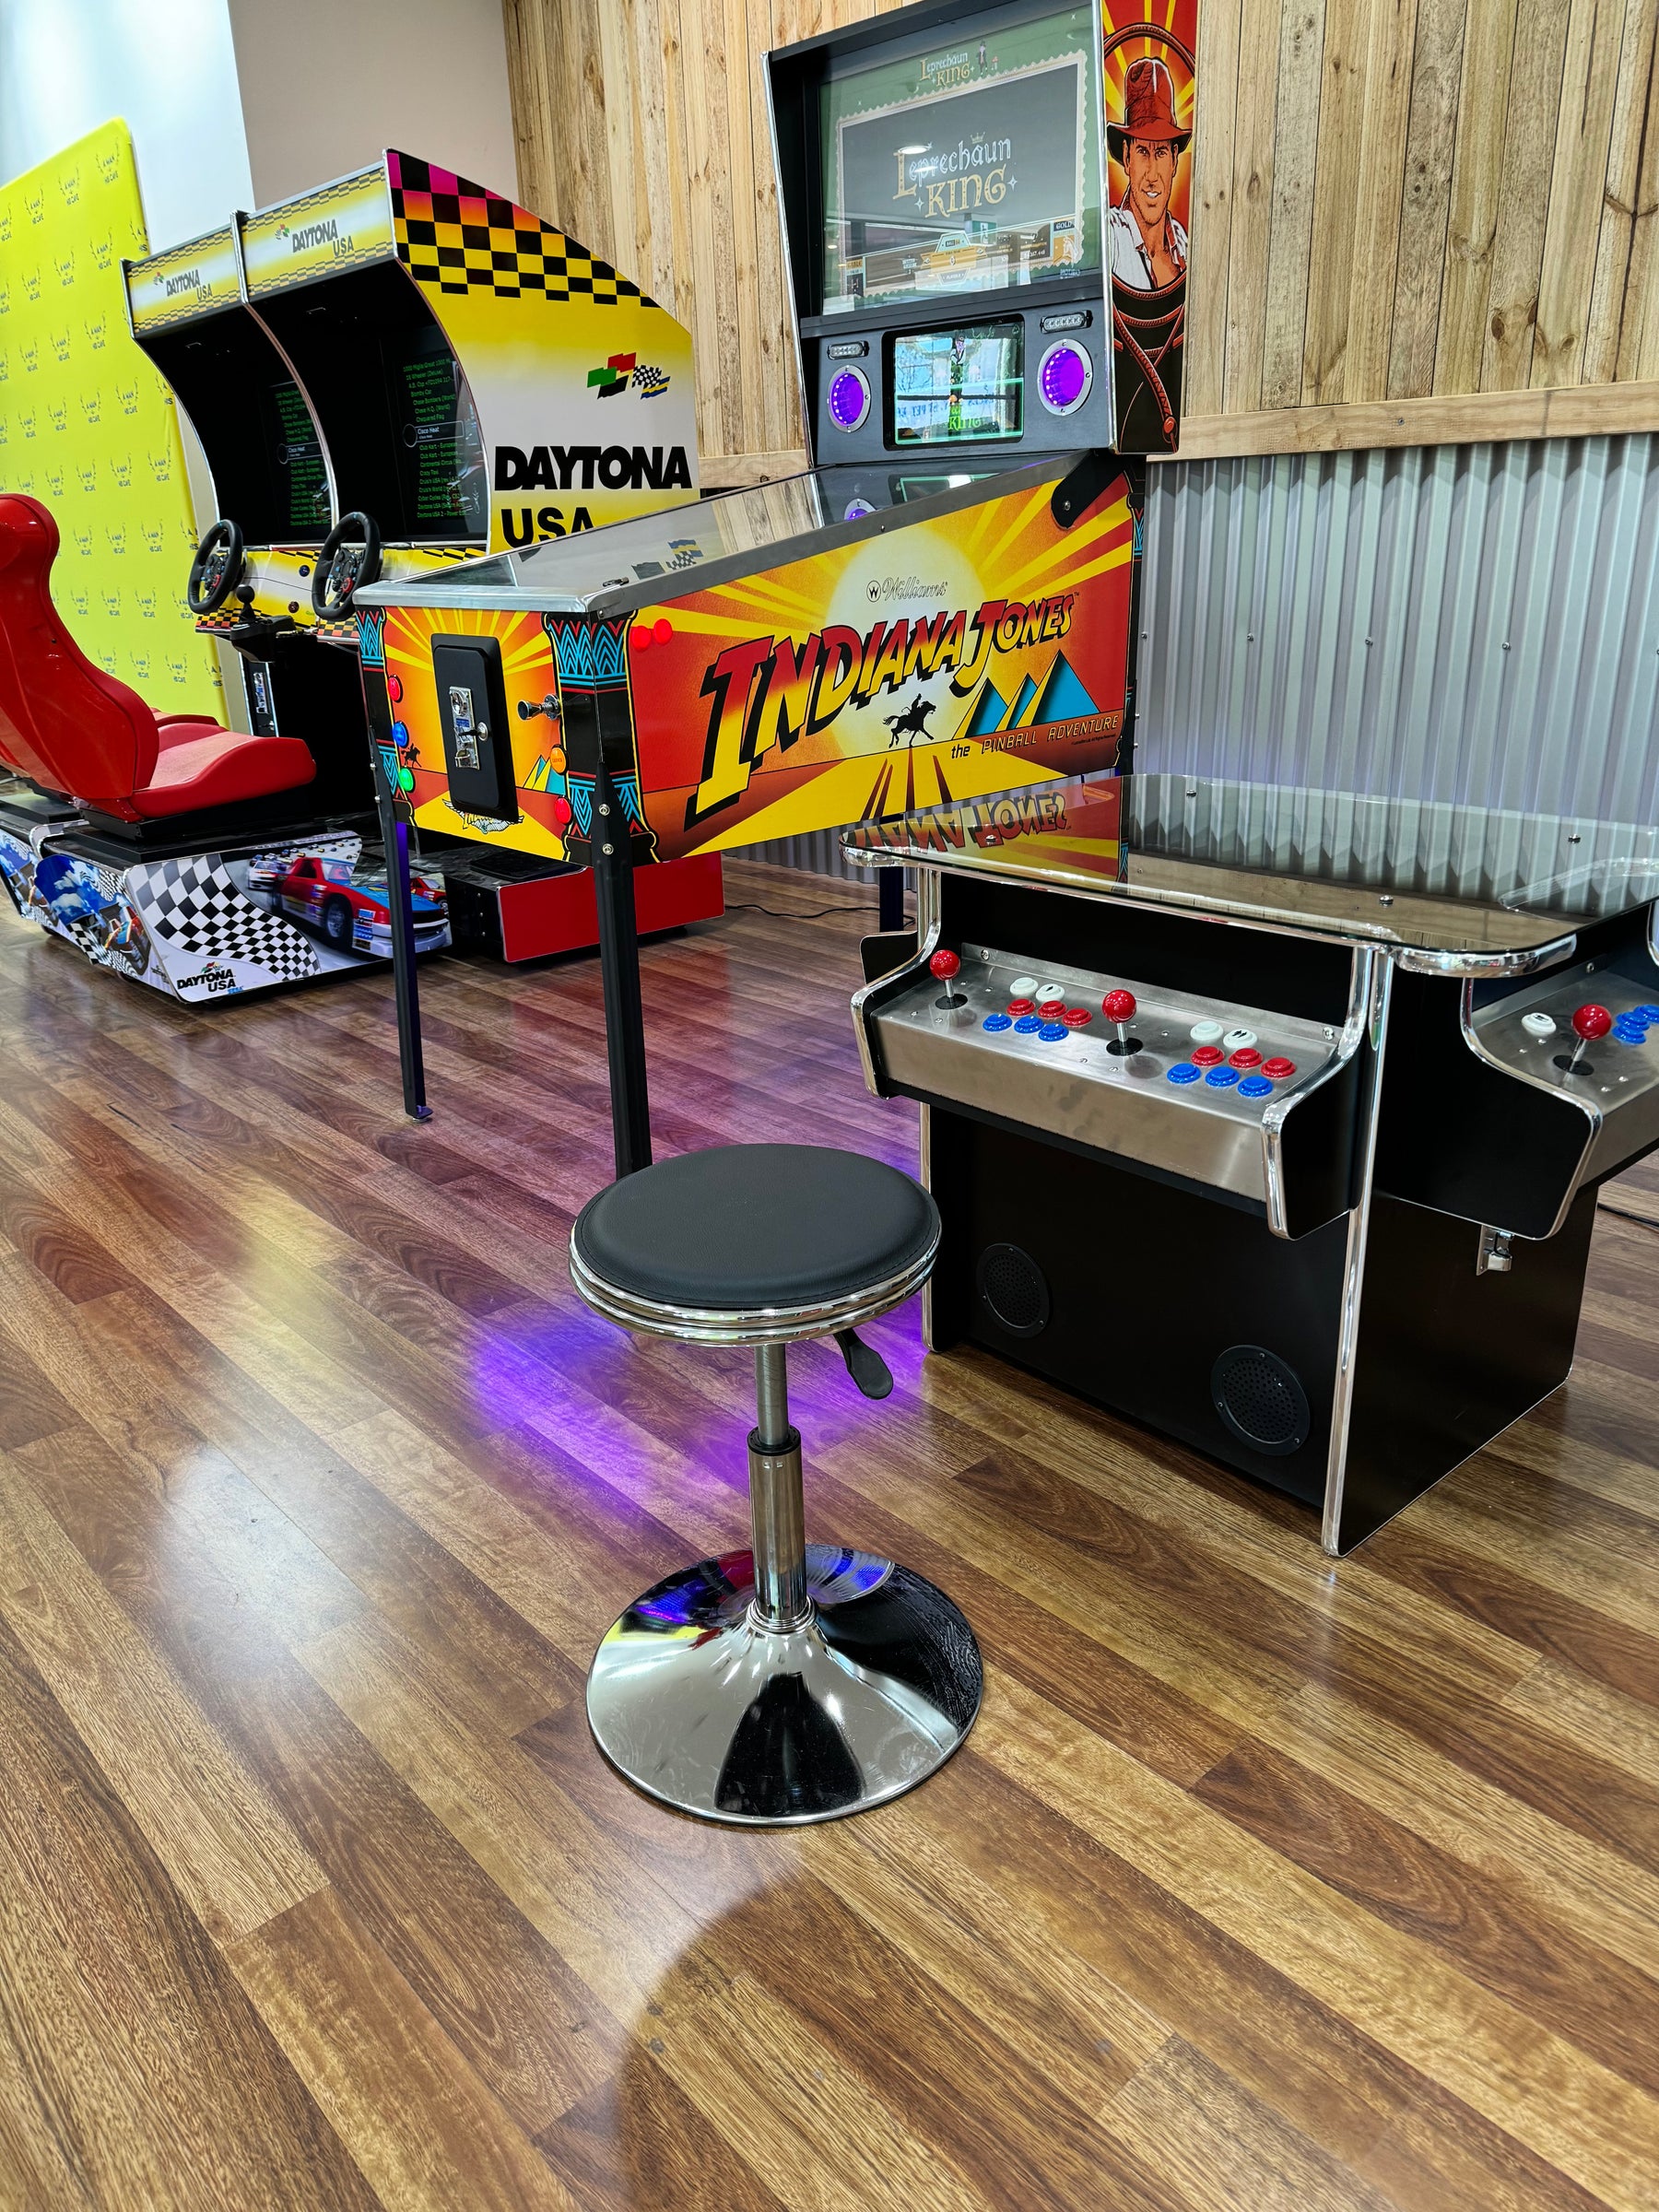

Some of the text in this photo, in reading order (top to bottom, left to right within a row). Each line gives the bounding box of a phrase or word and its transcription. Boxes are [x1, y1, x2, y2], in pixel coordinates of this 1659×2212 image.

[920, 53, 968, 81] Leprechaun
[893, 137, 1012, 200] Leprechaun
[924, 163, 1007, 218] KING
[292, 218, 338, 253] DAYTONA
[1055, 221, 1072, 230] GOLD
[333, 235, 354, 256] USA
[166, 269, 200, 297] DAYTONA
[196, 283, 213, 300] USA
[495, 445, 692, 490] DAYTONA
[500, 507, 594, 548] USA
[684, 609, 968, 830] INDIANA
[948, 594, 1075, 699] JONES
[951, 714, 1119, 759] the PINBALL ADVENTURE
[177, 969, 234, 990] DAYTONA
[208, 979, 236, 993] USA
